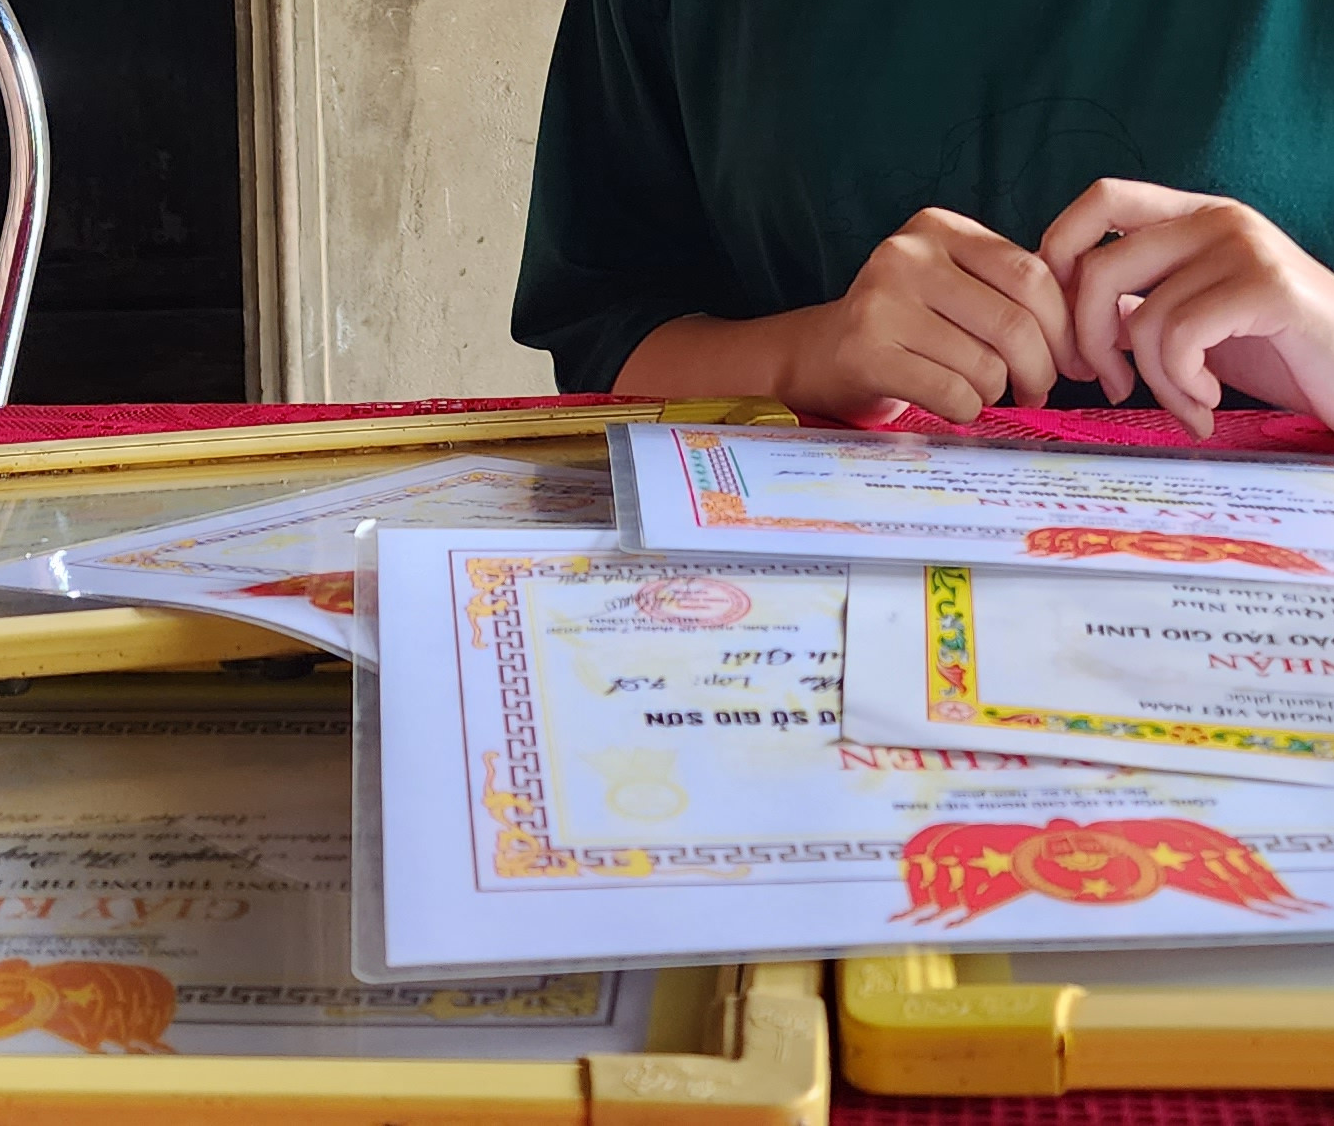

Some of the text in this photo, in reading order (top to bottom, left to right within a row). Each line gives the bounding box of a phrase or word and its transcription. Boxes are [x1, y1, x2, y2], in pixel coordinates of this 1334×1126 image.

[1169, 597, 1226, 614] Như
[1083, 621, 1150, 638] LINH
[1161, 627, 1212, 642] GIO
[1221, 630, 1279, 646] TẠO
[1138, 700, 1191, 714] NAM
[642, 709, 704, 728] SƠN
[712, 709, 761, 726] GIO
[768, 708, 809, 731] SỞ
[836, 745, 1028, 770] KHEN
